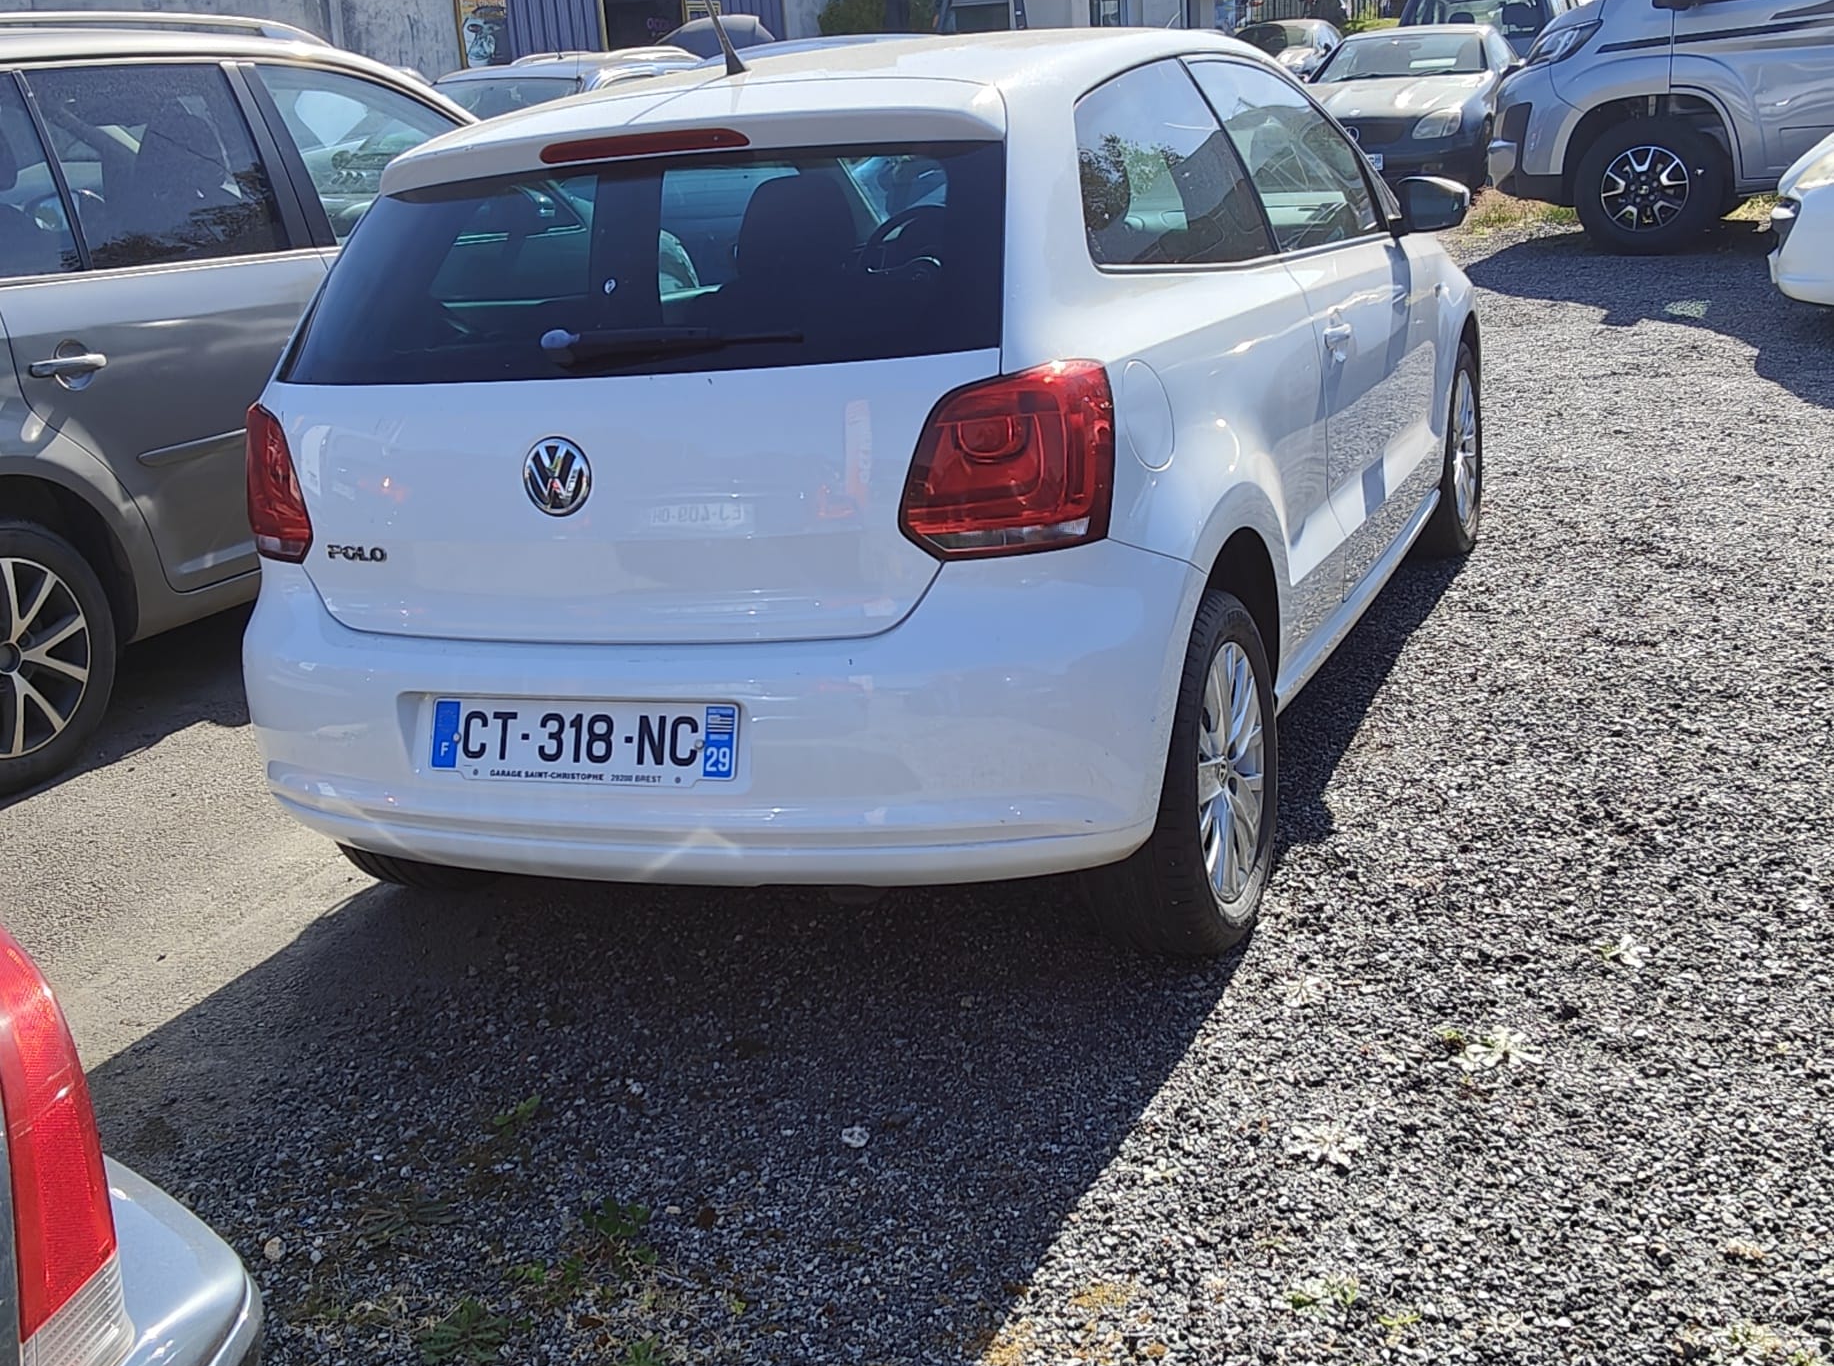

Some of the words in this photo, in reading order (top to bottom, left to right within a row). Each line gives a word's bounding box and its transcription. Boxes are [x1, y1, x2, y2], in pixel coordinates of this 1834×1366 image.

[327, 544, 387, 562] POLO
[462, 710, 699, 767] CT-318-NC
[440, 741, 450, 757] F
[705, 747, 730, 772] 29
[490, 769, 522, 778] GARAGE
[524, 770, 604, 781] SAINT-CHRISTOPHE
[635, 774, 662, 784] BREST
